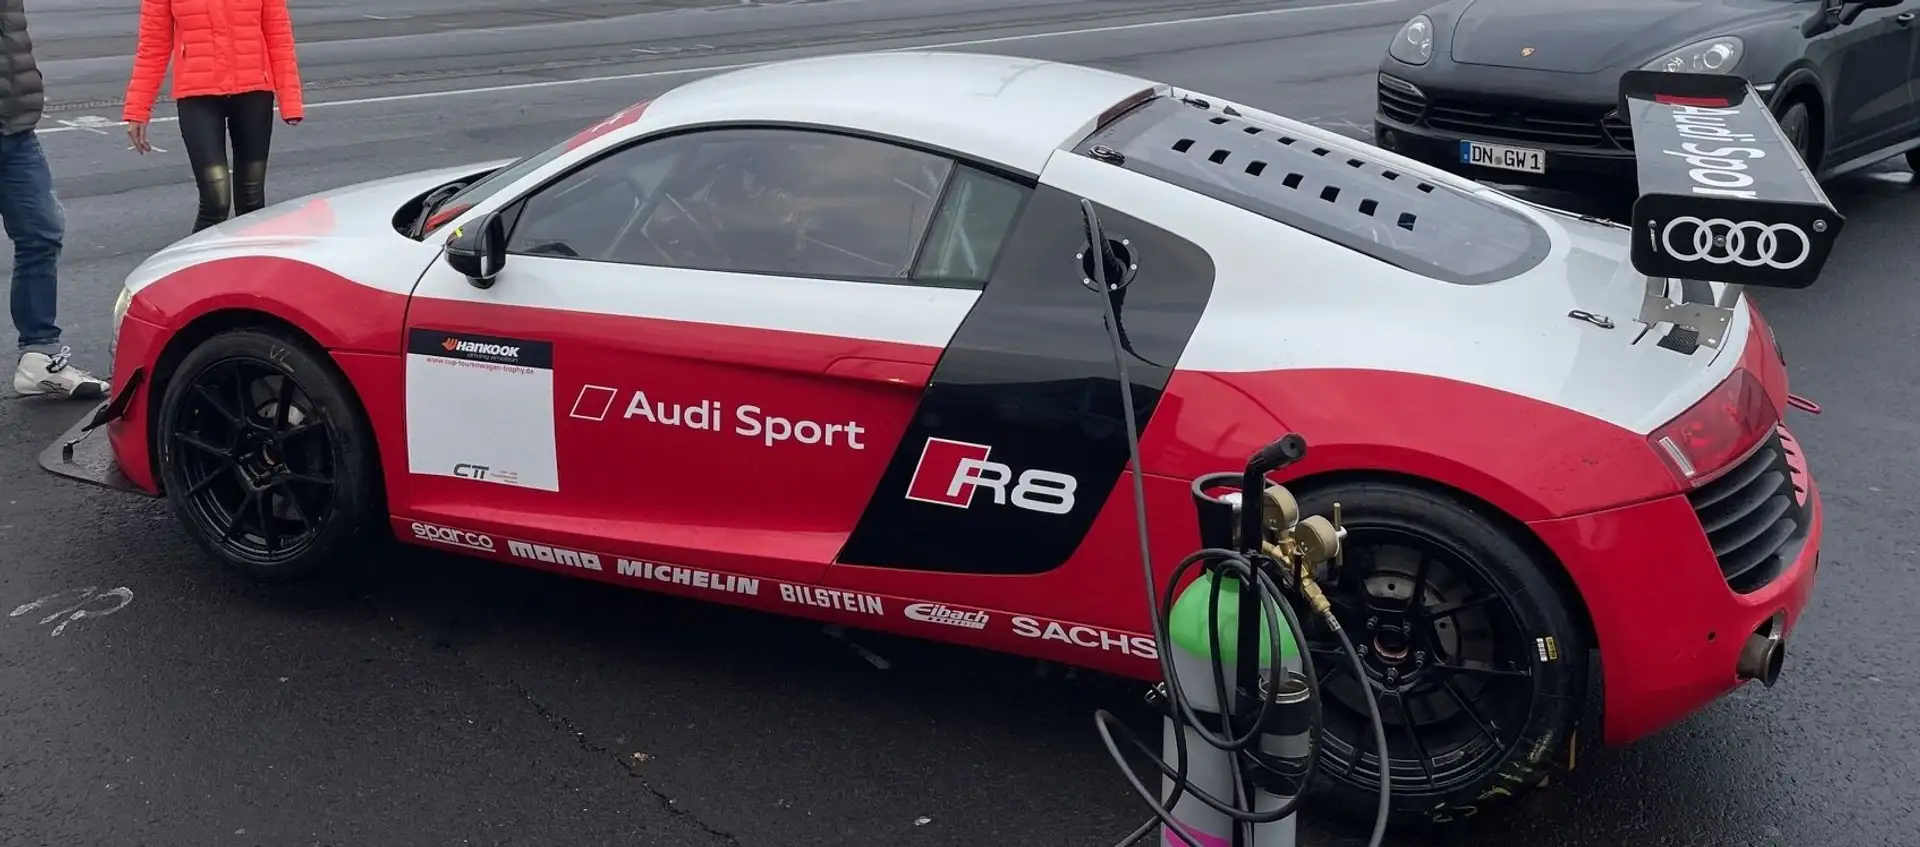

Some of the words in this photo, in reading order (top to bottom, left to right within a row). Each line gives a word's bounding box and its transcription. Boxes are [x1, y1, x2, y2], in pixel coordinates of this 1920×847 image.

[1672, 105, 1756, 142] Audi
[1471, 145, 1493, 164] DN
[1504, 149, 1526, 168] GW
[1530, 153, 1541, 170] 1
[1663, 141, 1766, 199] Spor
[623, 390, 721, 432] Audi
[735, 404, 865, 450] Sport
[946, 457, 1078, 515] R8
[411, 521, 494, 549] sparco
[617, 558, 760, 596] MICHELIN
[779, 583, 884, 616] BILSTEIN
[904, 603, 989, 627] Eibach
[1011, 616, 1159, 660] SACHS
